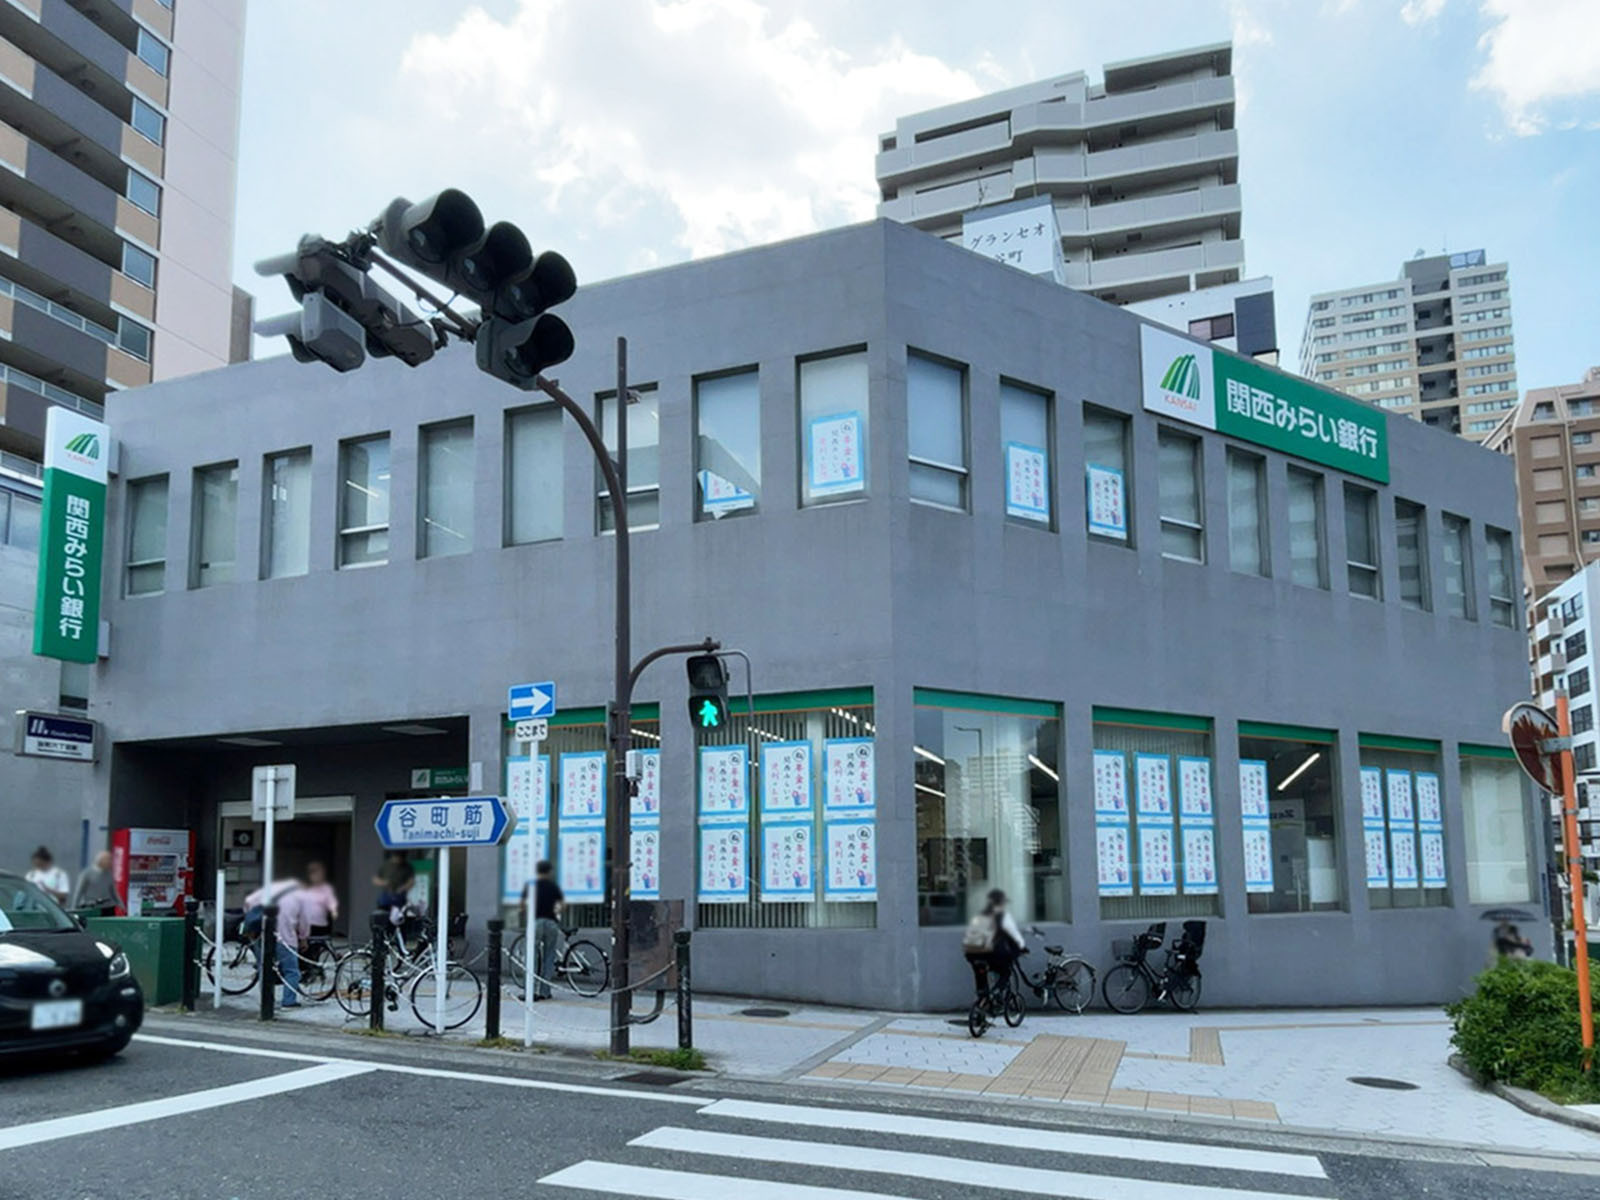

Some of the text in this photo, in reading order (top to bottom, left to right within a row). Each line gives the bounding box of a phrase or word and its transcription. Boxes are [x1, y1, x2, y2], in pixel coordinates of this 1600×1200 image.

[971, 223, 1045, 249] グランセオ
[1226, 378, 1378, 459] 関西みらい銀行
[59, 494, 90, 640] 関西みらい銀行
[517, 724, 545, 737] ここまで
[399, 804, 483, 828] 谷町筋
[402, 827, 480, 841] Tanimachi-suji
